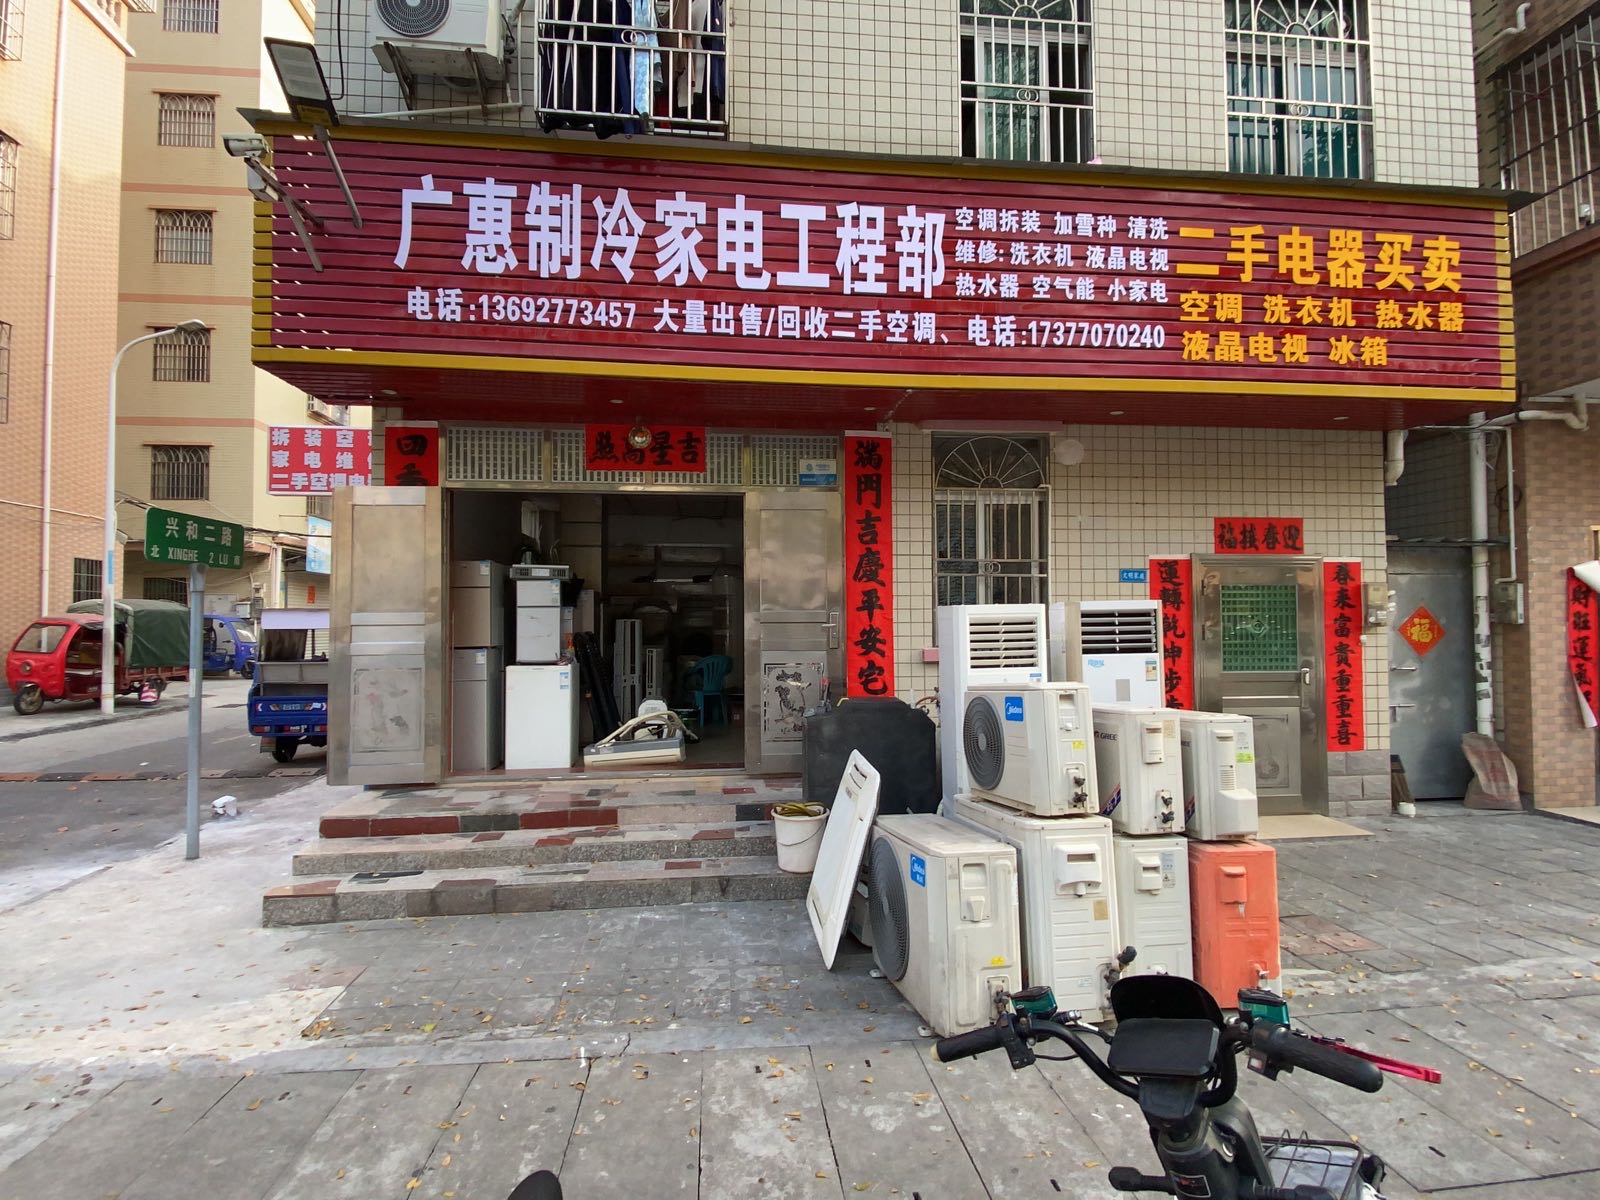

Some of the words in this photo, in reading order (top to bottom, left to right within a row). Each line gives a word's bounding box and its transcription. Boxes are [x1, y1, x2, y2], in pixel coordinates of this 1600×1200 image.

[394, 174, 946, 298] 广惠制冷家电工程部
[955, 207, 1040, 233] 空调拆装
[1054, 212, 1116, 238] 加雪种
[1128, 216, 1169, 240] 清洗
[1086, 245, 1169, 271] 液晶电视
[1176, 224, 1462, 293] 二手电器买卖
[956, 272, 1020, 299] 热水器
[1032, 275, 1095, 301] 空气能
[1107, 278, 1168, 303] 小家电
[407, 286, 635, 328] 电话:13692773457
[968, 315, 1165, 348] 电话:17377070240
[1179, 291, 1243, 323] 空调
[1263, 294, 1357, 327] 洗衣机
[1375, 300, 1464, 332] 热水器
[1181, 330, 1309, 363] 液晶电视
[1329, 335, 1388, 366] 冰箱
[272, 428, 372, 448] 拆装空
[272, 450, 372, 469] 家电维
[271, 472, 372, 490] 二手空调电
[165, 517, 232, 547] 兴和二路
[150, 544, 160, 558] 北
[167, 546, 199, 562] XINGHE
[208, 552, 215, 564] 2
[219, 553, 229, 565] LU
[1411, 617, 1433, 643] 福
